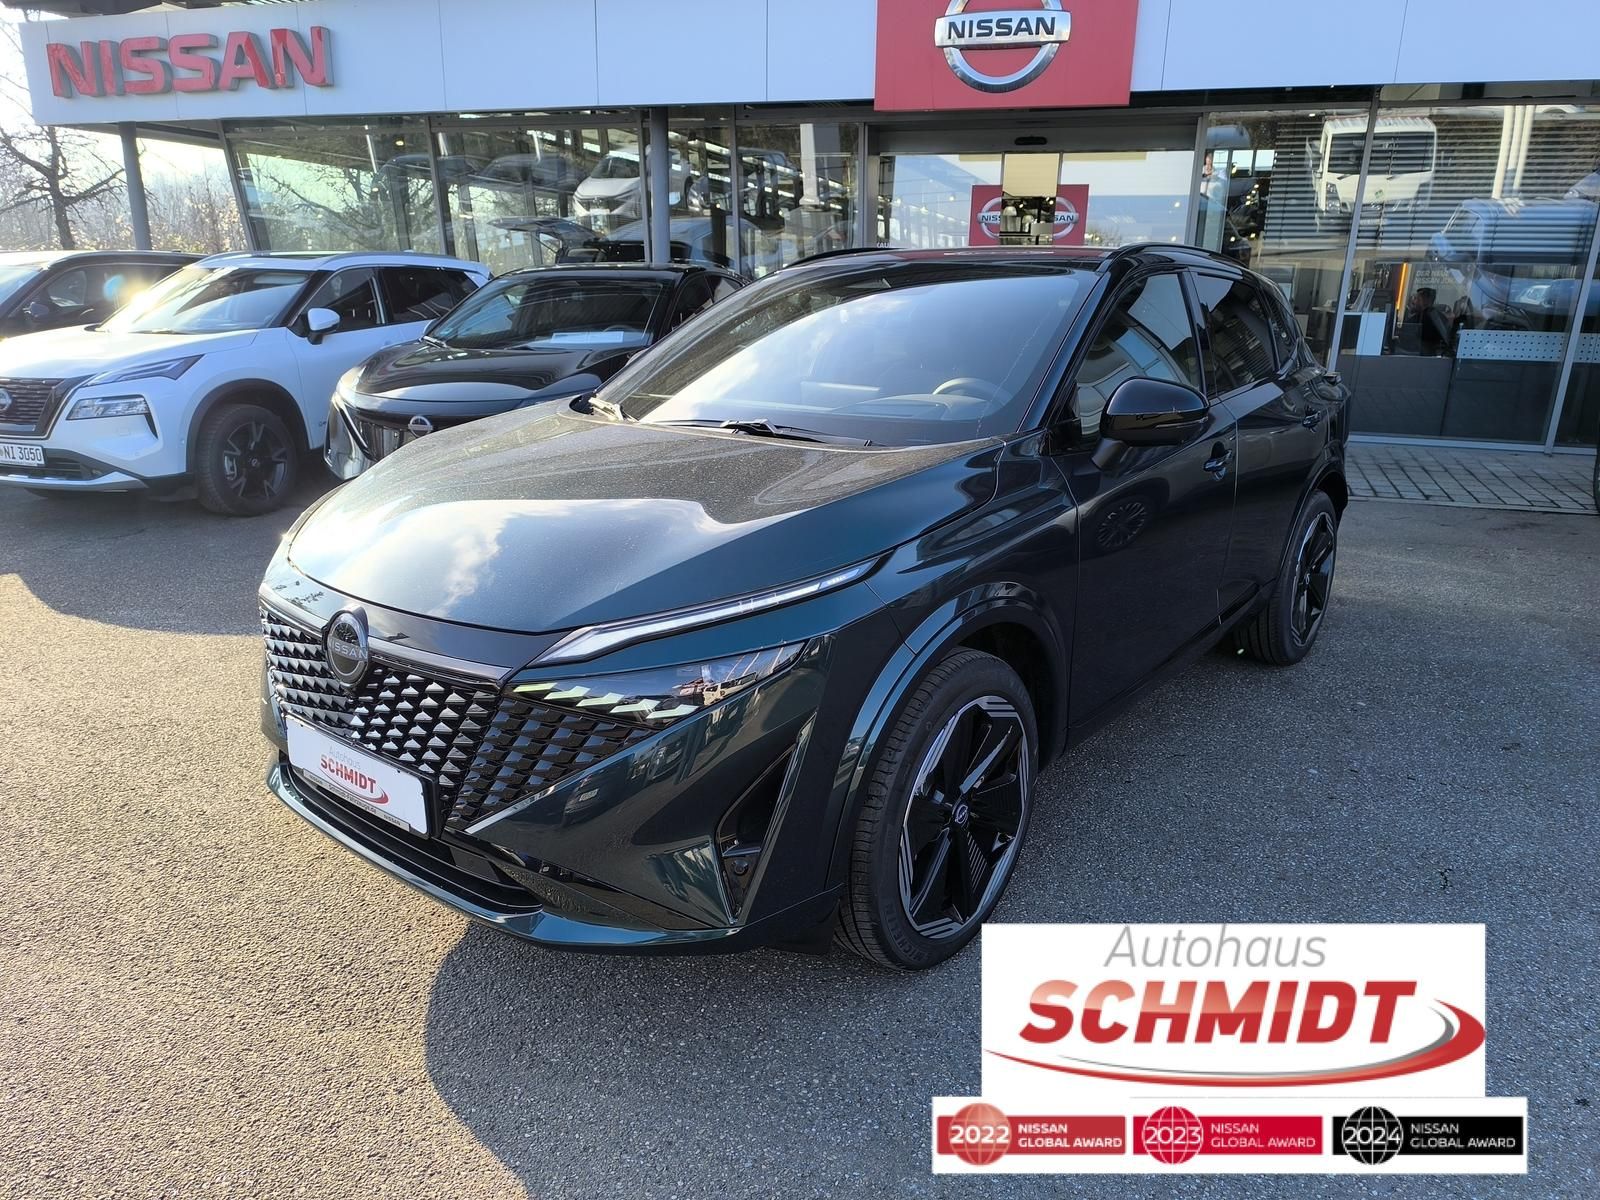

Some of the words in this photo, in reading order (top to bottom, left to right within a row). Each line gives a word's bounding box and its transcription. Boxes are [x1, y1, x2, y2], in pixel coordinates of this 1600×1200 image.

[947, 16, 1056, 40] NISSAN
[46, 26, 332, 98] NISSAN
[17, 446, 42, 462] 3050
[321, 753, 377, 794] SCHMIDT
